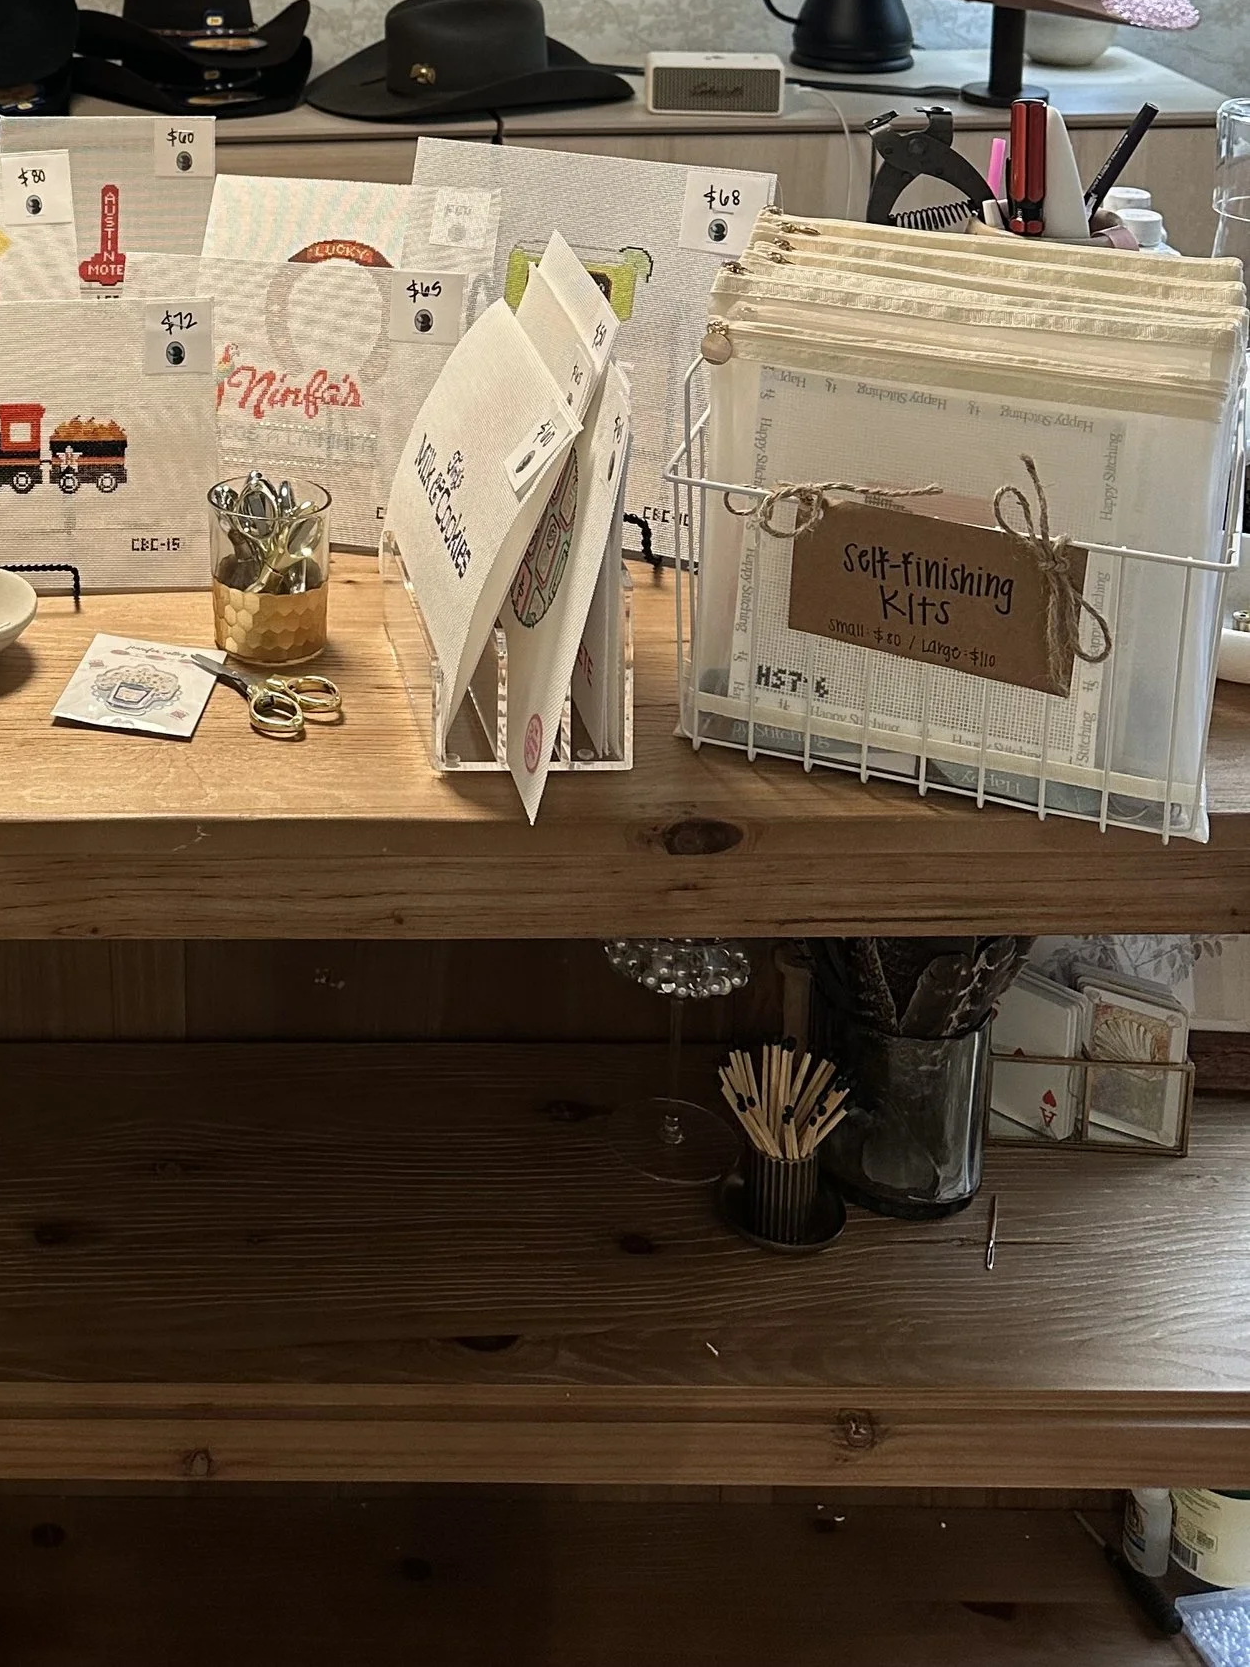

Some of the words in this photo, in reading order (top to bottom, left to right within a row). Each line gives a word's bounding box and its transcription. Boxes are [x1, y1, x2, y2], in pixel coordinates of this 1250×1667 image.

[166, 128, 194, 147] $60
[17, 167, 46, 187] $80
[703, 184, 740, 210] $68
[103, 192, 116, 262] AUSTIN
[315, 245, 367, 261] LUCKY
[88, 264, 125, 276] MOTE
[406, 280, 442, 303] $65
[161, 310, 198, 335] $72
[227, 365, 365, 419] Ninfa's
[857, 382, 907, 404] Stitching
[909, 391, 948, 411] Happy
[1000, 404, 1051, 427] Stitching
[1054, 411, 1094, 433] Happy
[1103, 432, 1124, 482] Stitching
[1100, 484, 1118, 521] Happy
[131, 538, 180, 551] CBC-15
[843, 543, 1014, 616] Self-finishing
[873, 626, 900, 647] $80
[908, 635, 915, 651] /
[1076, 711, 1096, 764] Stitching
